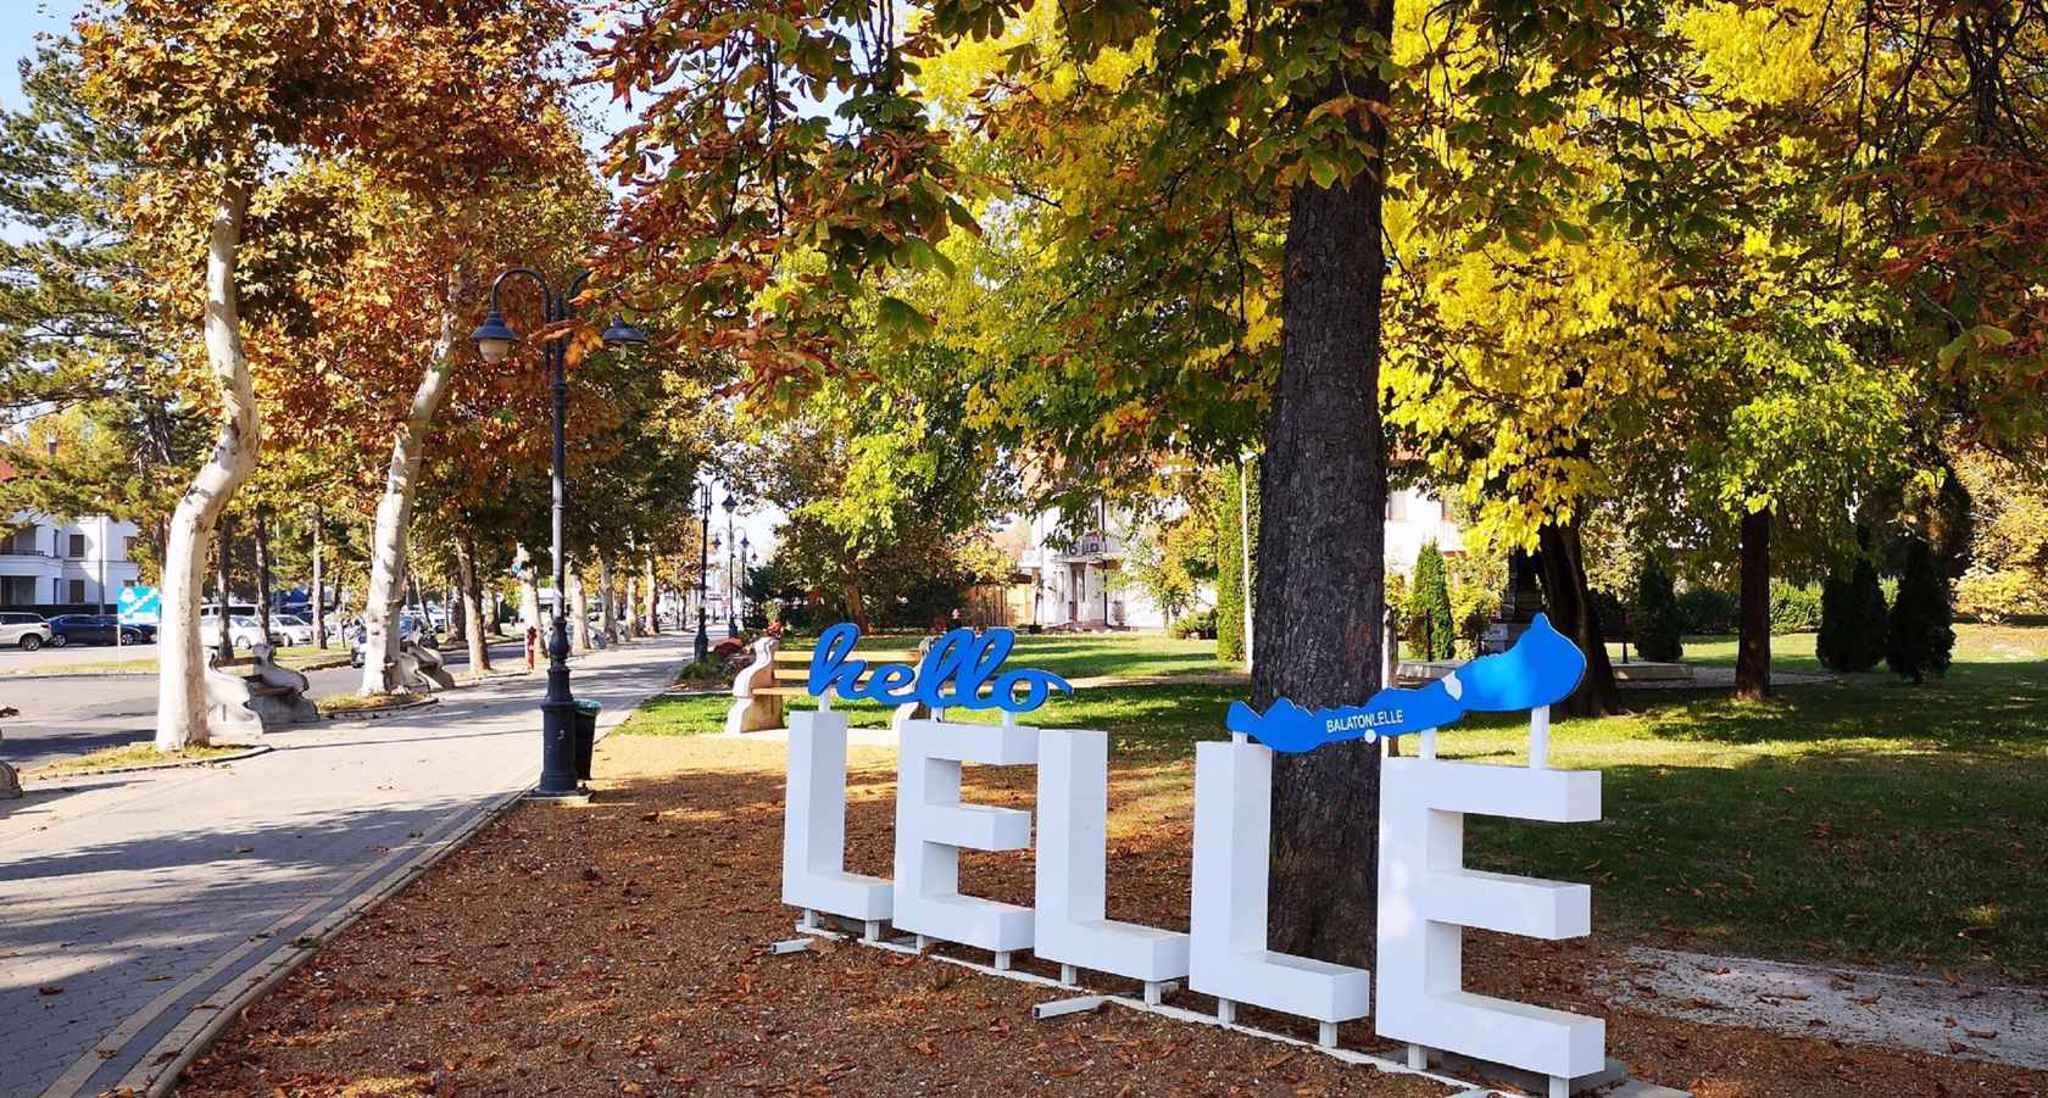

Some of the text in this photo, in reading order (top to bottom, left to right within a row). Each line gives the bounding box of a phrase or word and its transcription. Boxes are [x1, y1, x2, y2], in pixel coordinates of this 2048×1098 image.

[808, 622, 1074, 713] hello
[1326, 709, 1404, 733] BALATONLELLE
[782, 710, 1605, 1080] LELLE
